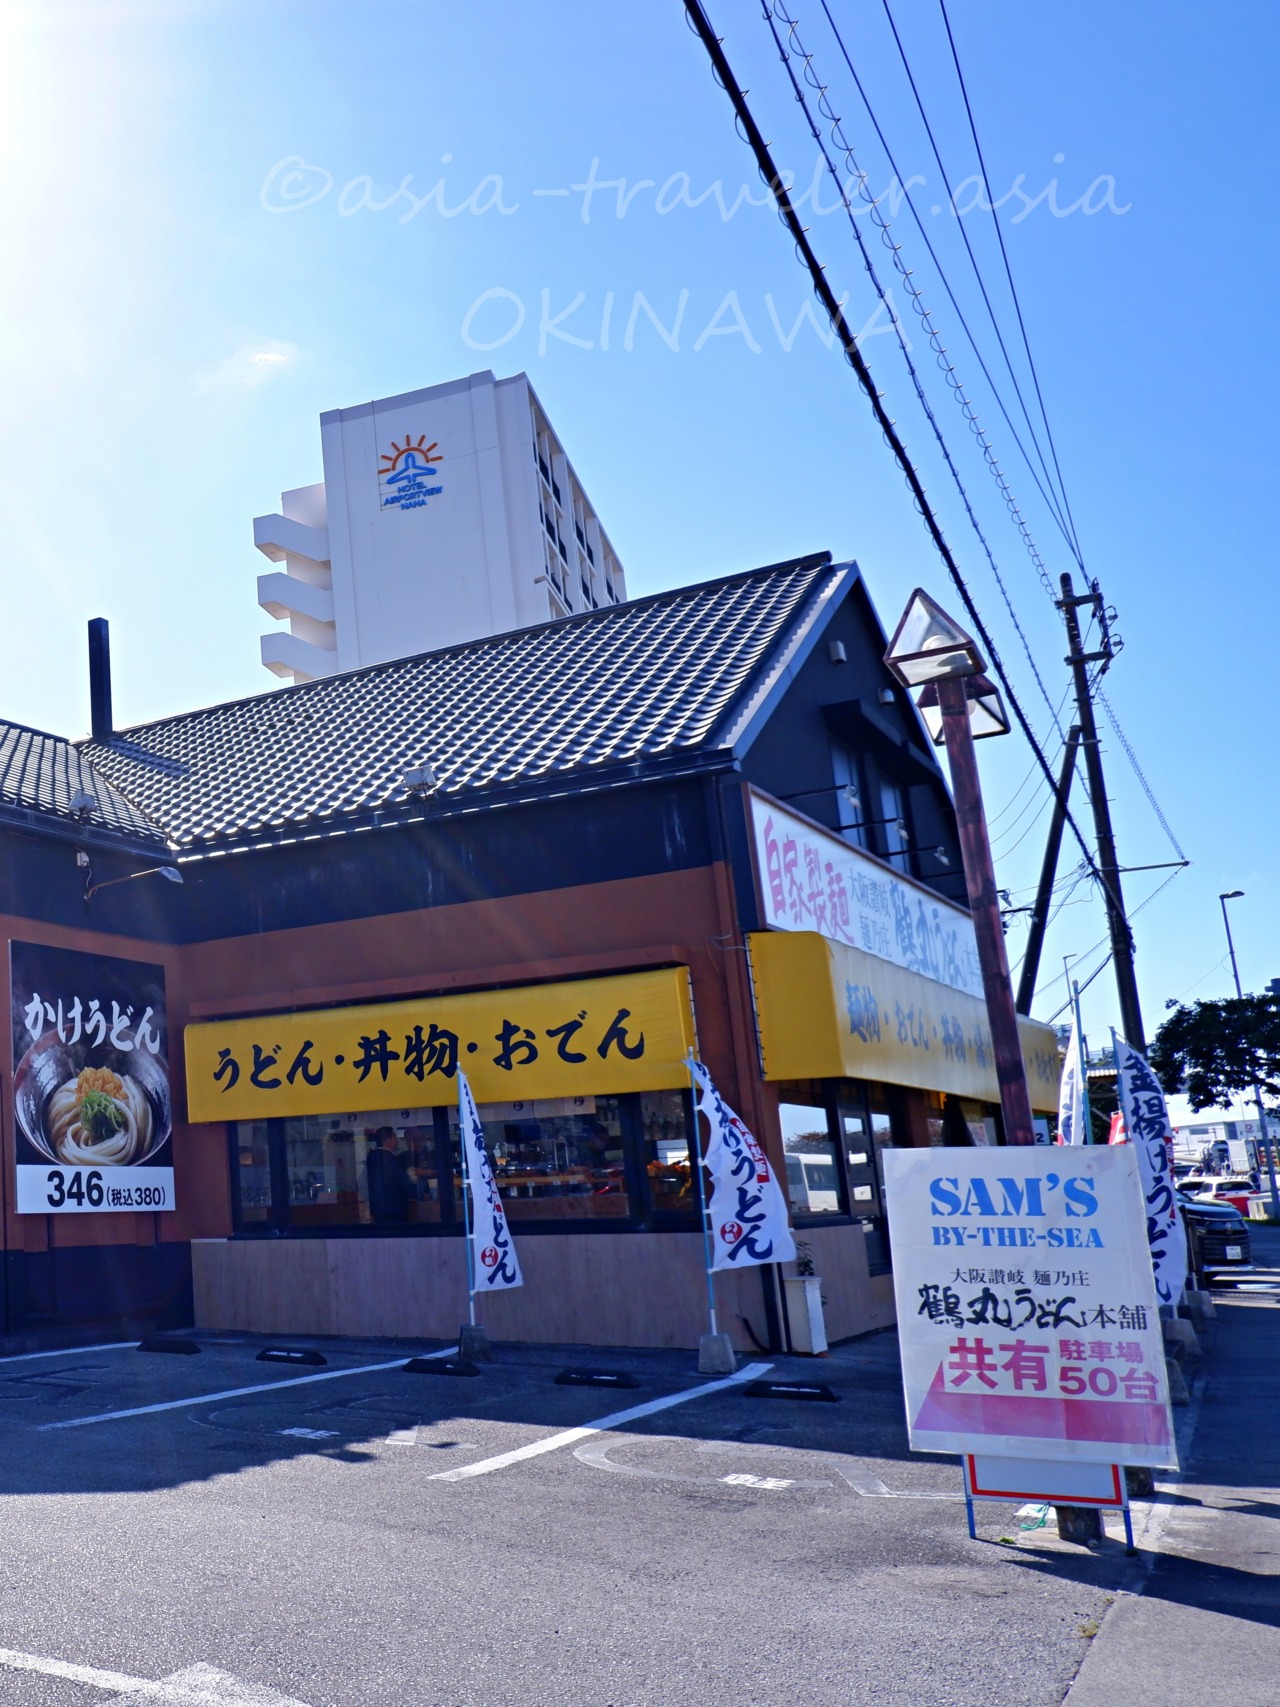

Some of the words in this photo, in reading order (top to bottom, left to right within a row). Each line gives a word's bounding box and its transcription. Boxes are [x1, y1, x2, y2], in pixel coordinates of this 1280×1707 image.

[398, 481, 427, 493] HOTEL
[401, 499, 427, 510] NAHA
[24, 992, 160, 1054] かけうどん
[47, 1170, 104, 1208] 346
[931, 1226, 1104, 1249] BY-THE-SEA
[1032, 1269, 1090, 1287] 麺乃庄
[948, 1337, 1049, 1391] 共有
[1058, 1339, 1144, 1364] 駐車場
[1058, 1366, 1160, 1401] 50台
